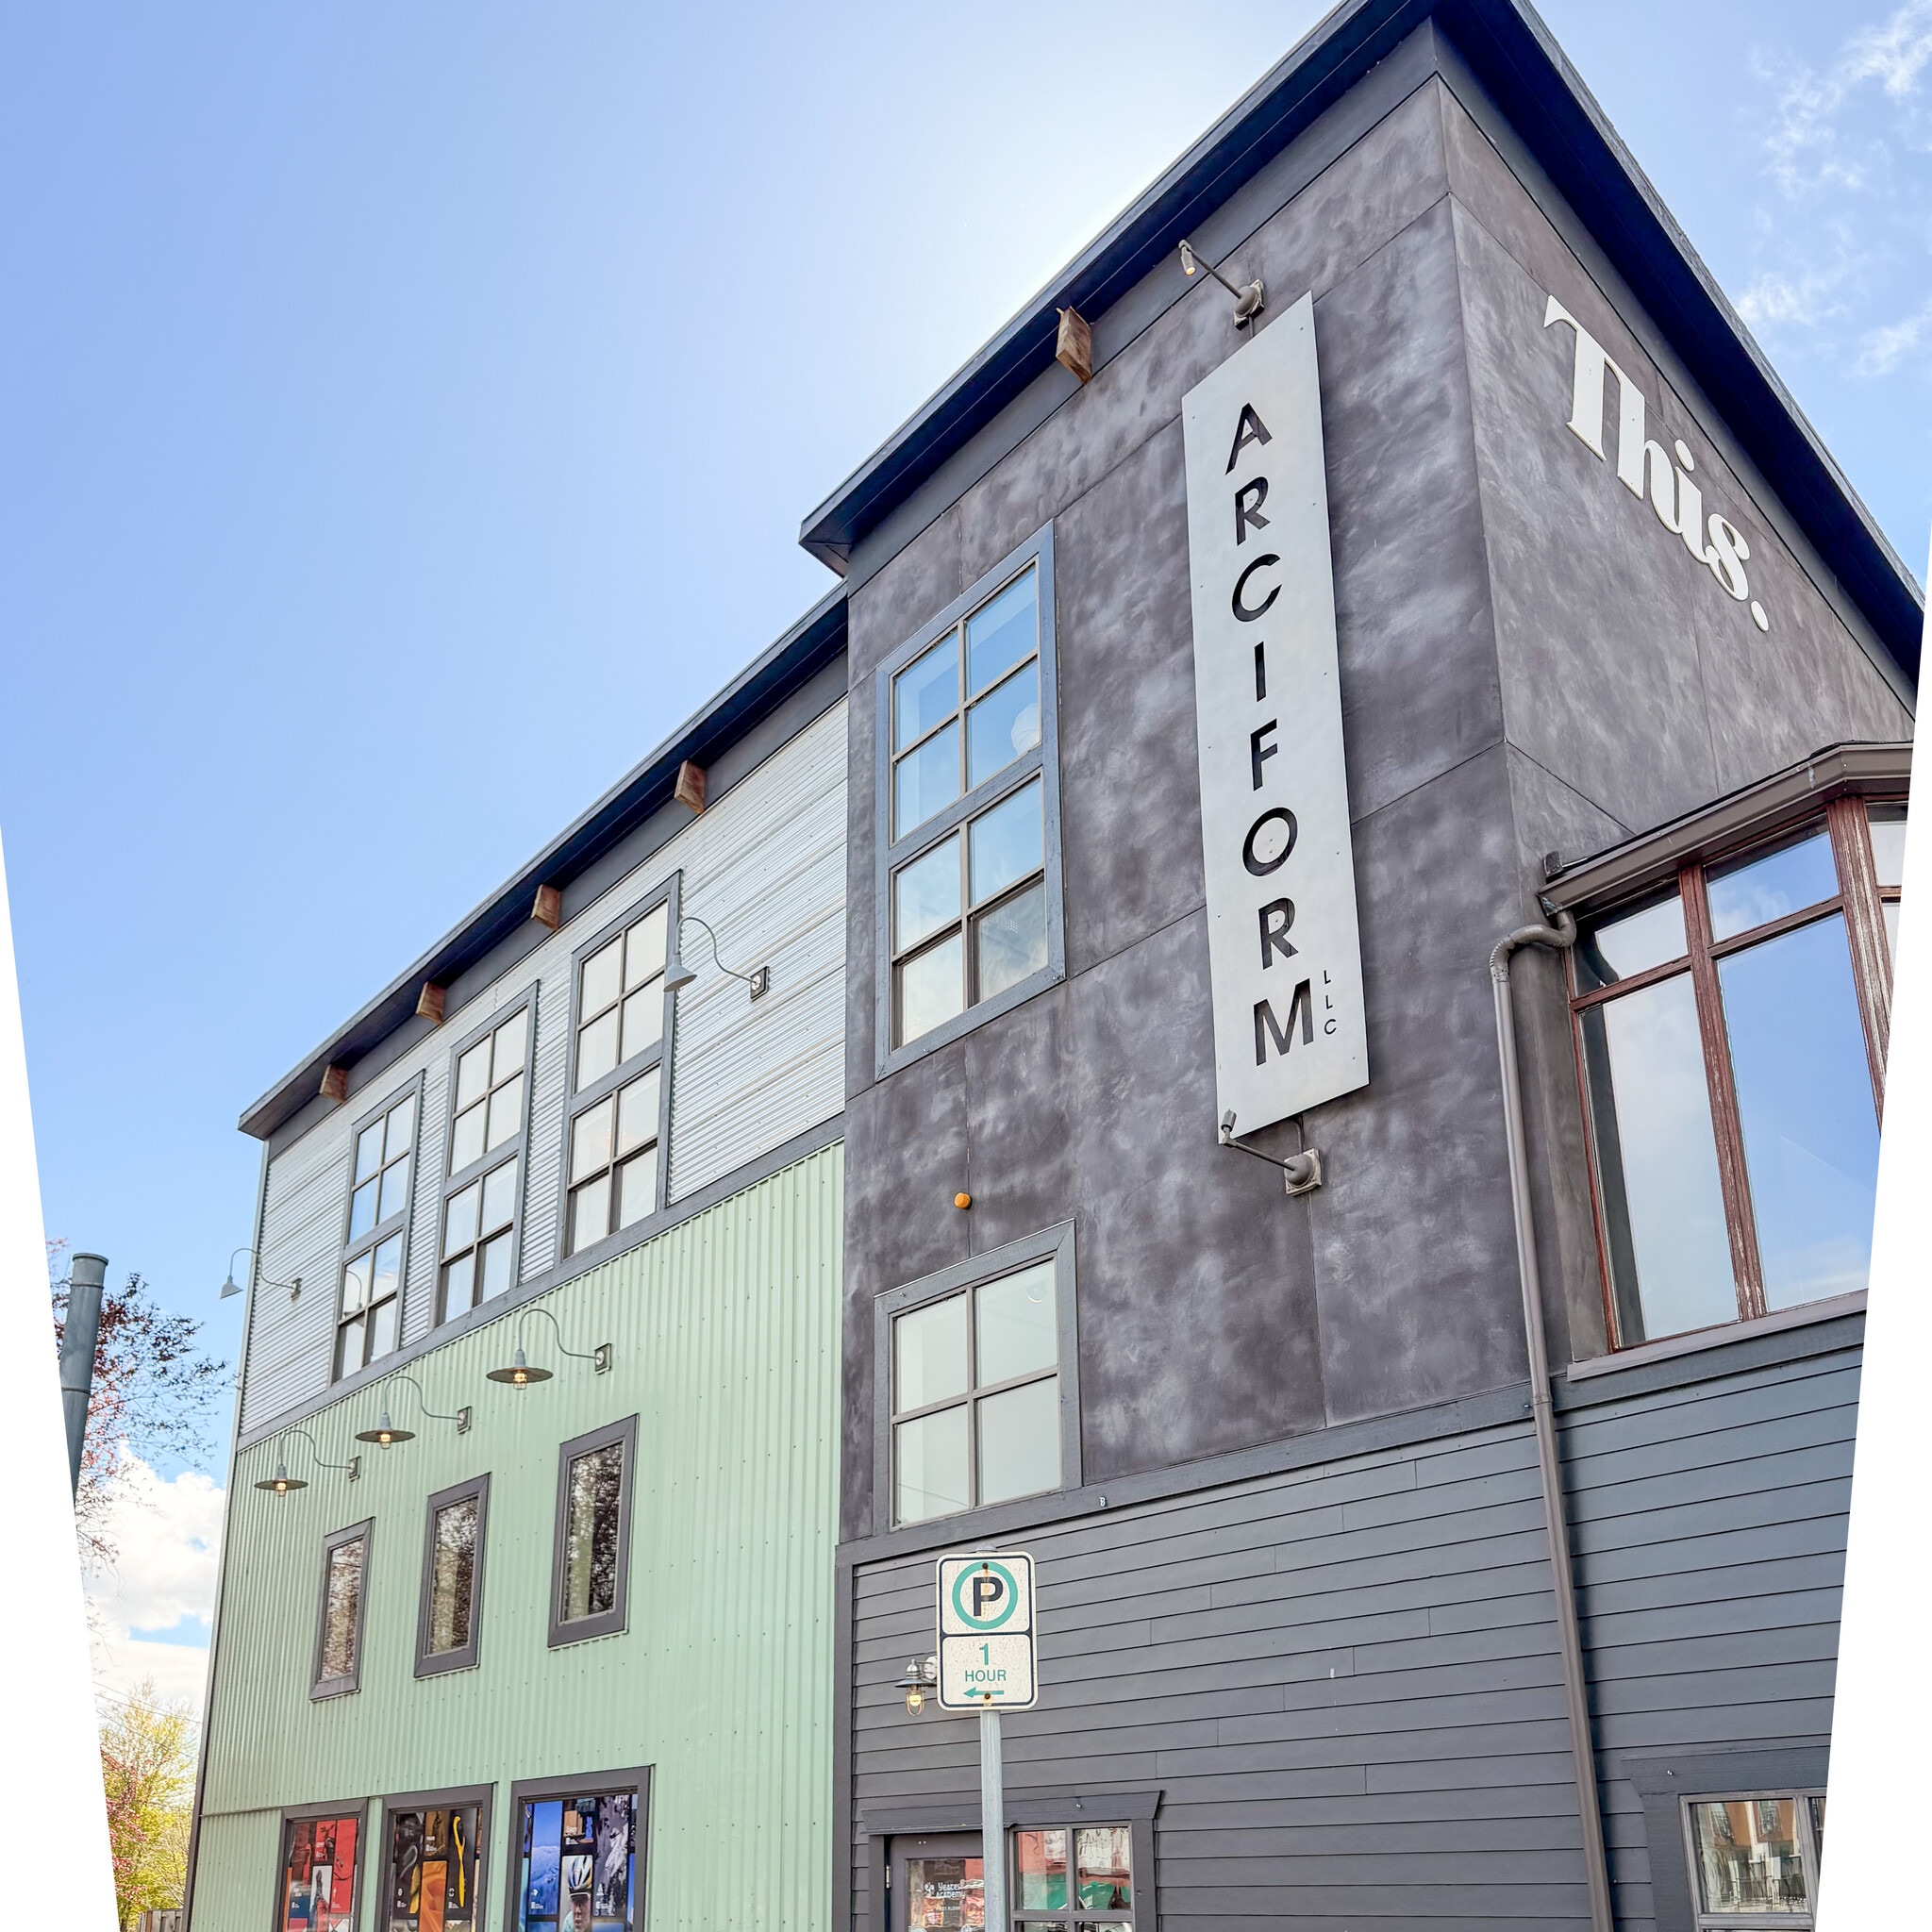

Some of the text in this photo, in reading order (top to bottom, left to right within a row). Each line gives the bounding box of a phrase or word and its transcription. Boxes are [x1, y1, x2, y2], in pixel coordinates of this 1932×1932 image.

[1225, 402, 1314, 1067] ARCIFORM
[1324, 970, 1337, 1035] LLC
[973, 1576, 1004, 1617] P
[978, 1642, 990, 1666] 1
[964, 1669, 1007, 1682] HOUR
